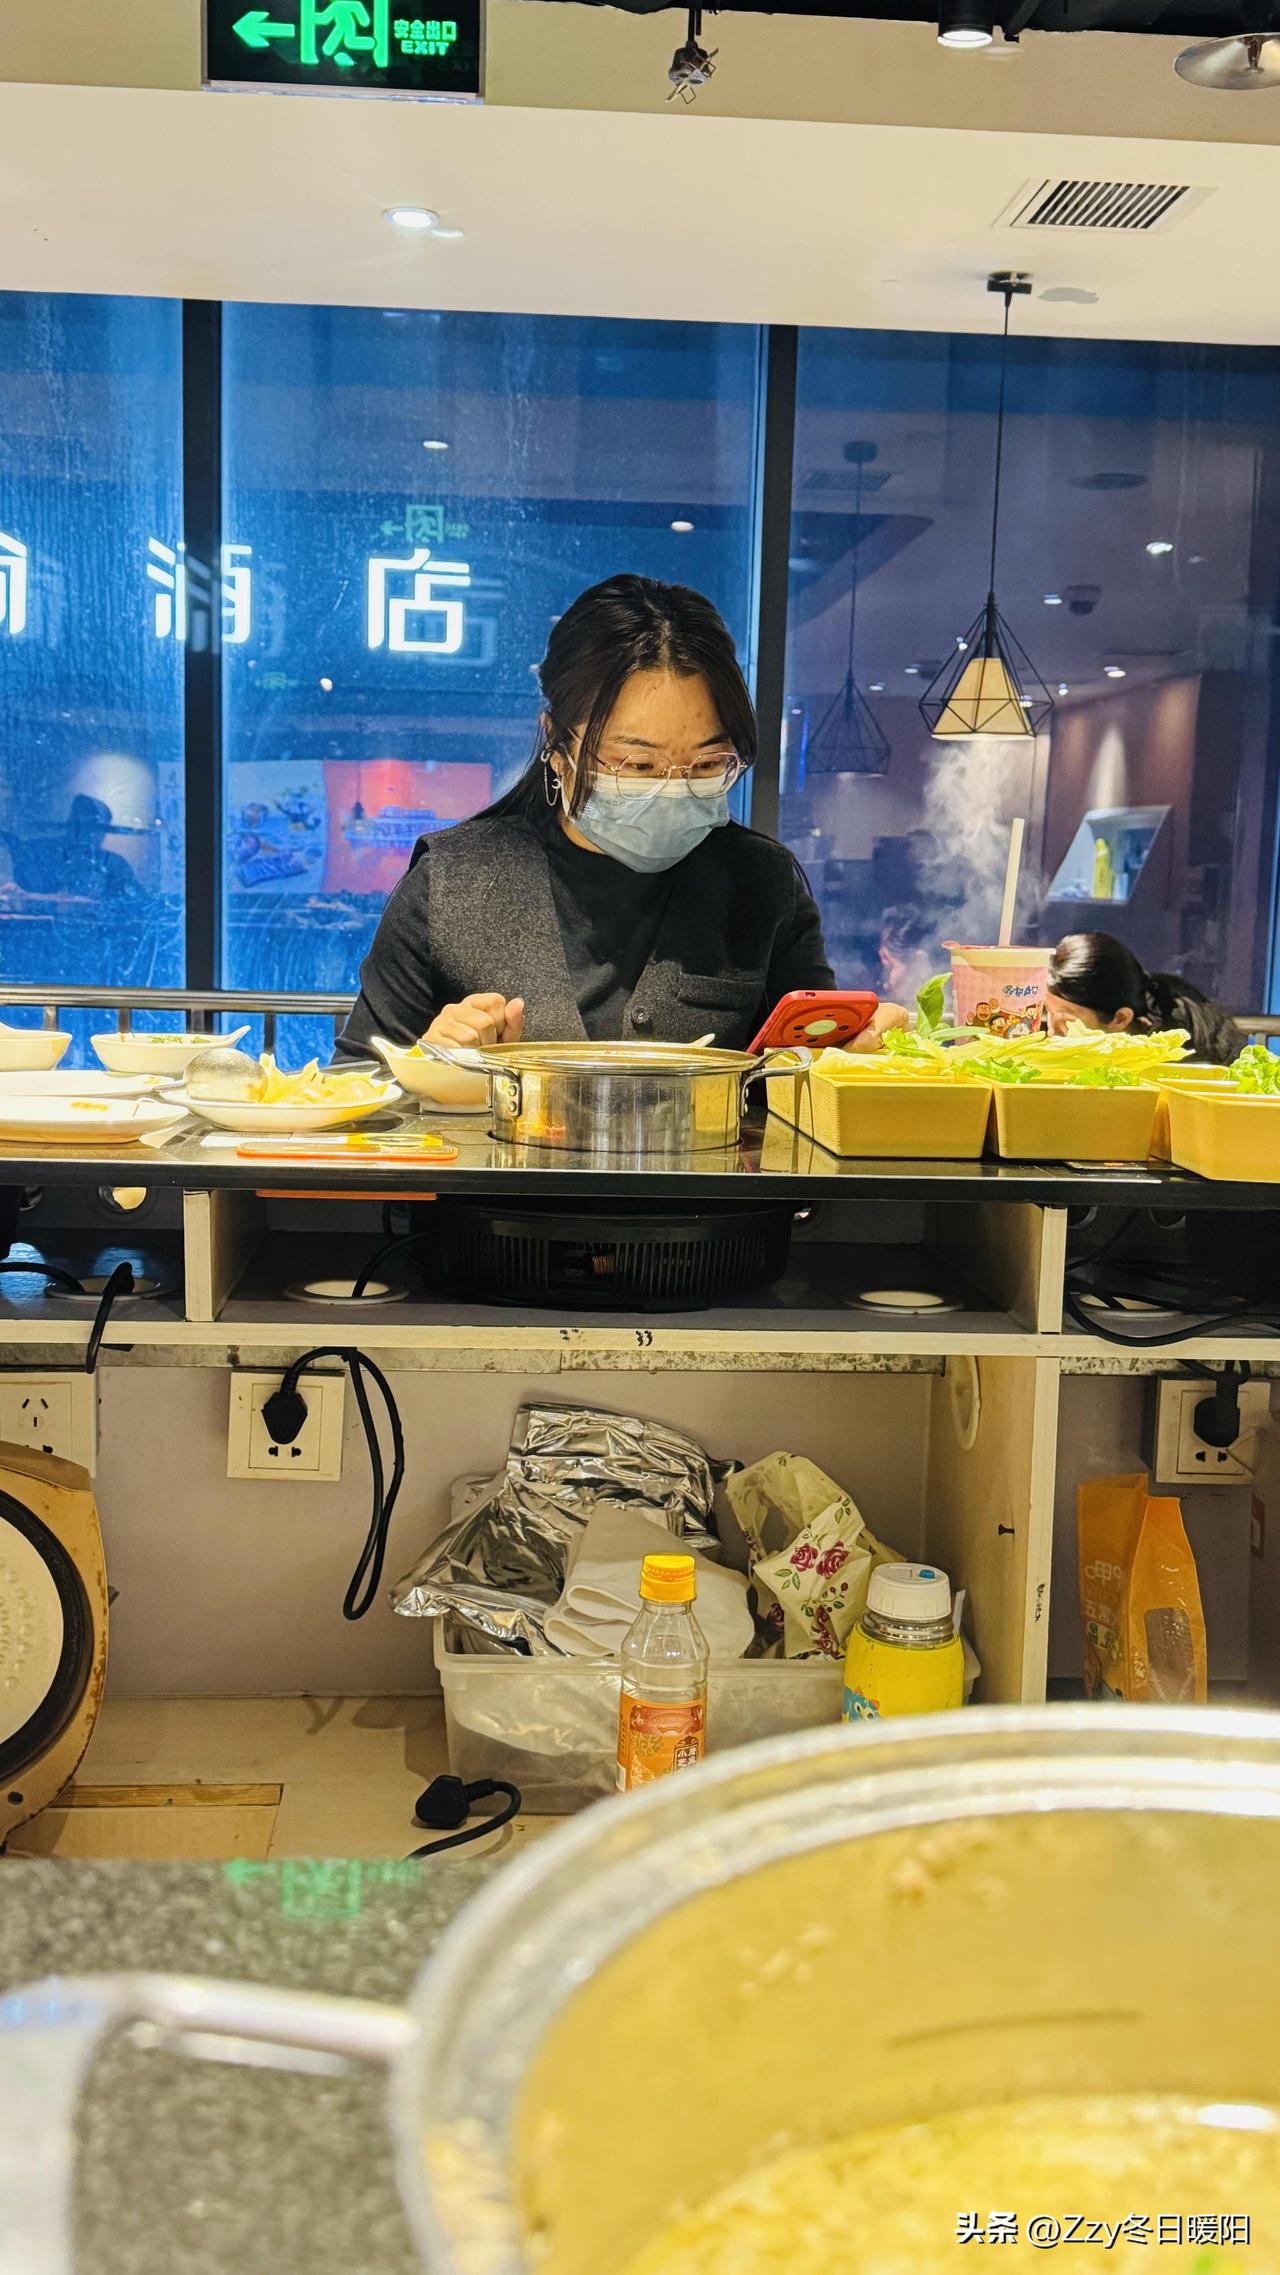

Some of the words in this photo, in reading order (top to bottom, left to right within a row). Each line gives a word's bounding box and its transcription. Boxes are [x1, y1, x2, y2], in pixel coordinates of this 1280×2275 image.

[393, 19, 457, 41] 安全出口
[401, 40, 449, 55] EXIT
